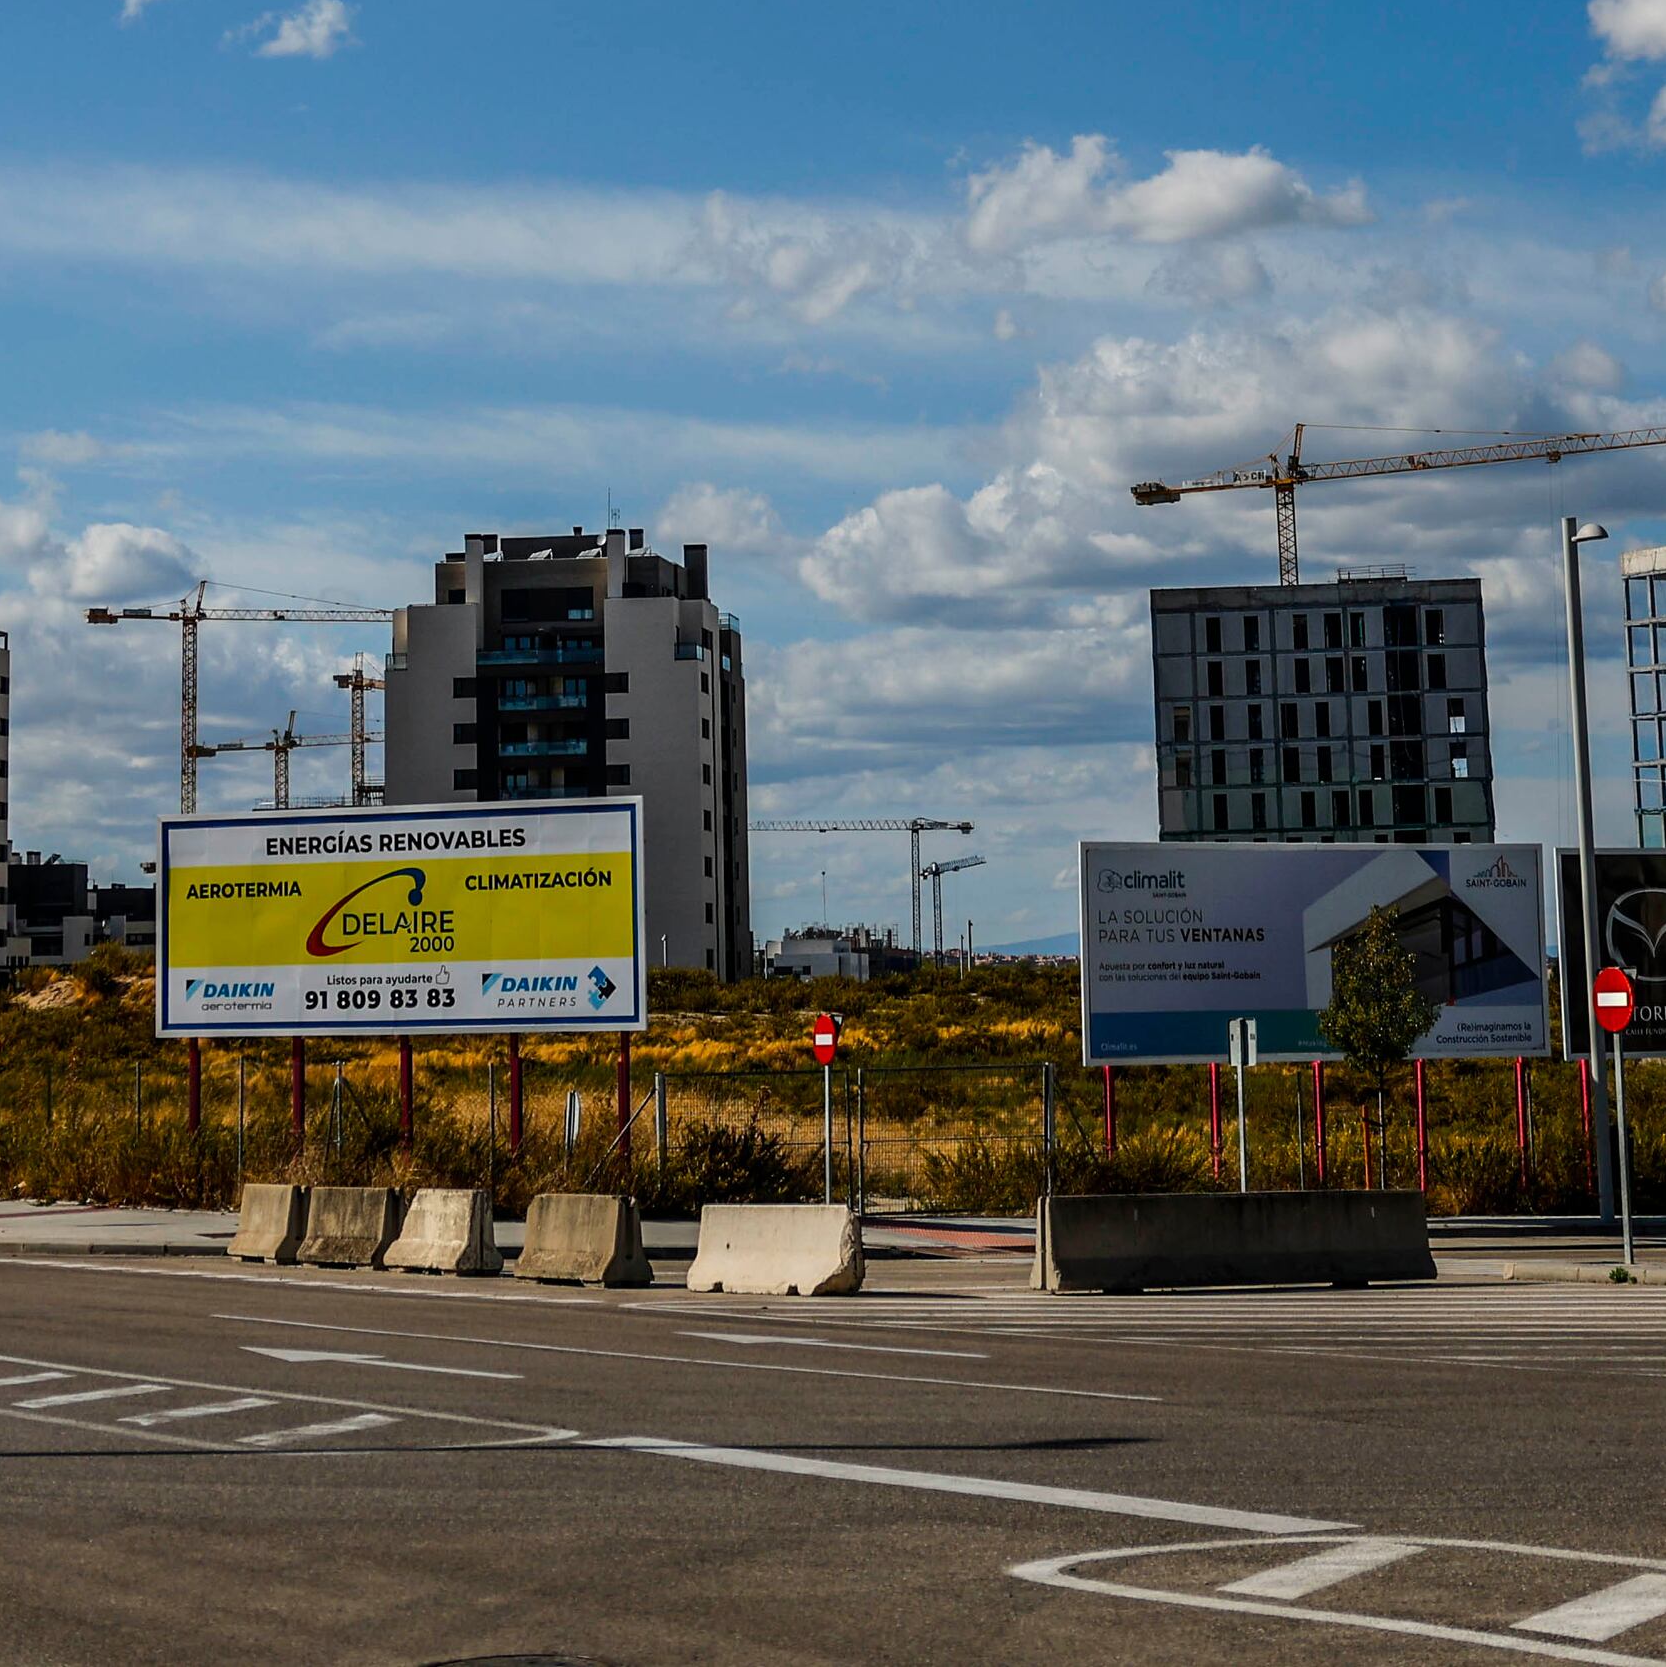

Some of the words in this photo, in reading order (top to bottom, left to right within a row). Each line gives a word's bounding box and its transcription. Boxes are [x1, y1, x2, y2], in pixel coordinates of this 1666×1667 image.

[266, 830, 373, 856] ENERGÍAS
[379, 828, 526, 852] RENOVABLES
[465, 867, 612, 891] CLIMATIZACIÓN
[1124, 870, 1185, 889] climalit
[1466, 879, 1527, 888] SAINT-GOBAIN
[186, 881, 302, 900] AEROTERMIA
[342, 910, 455, 936] DELAIRE
[1098, 910, 1118, 924] LA
[1124, 907, 1203, 923] SOLUCIÓN
[1099, 929, 1141, 943] PARA
[1146, 929, 1175, 942] TUS
[1180, 928, 1265, 942] VENTANAS
[410, 936, 455, 953] 2000
[1099, 962, 1131, 971] Apuesta
[1132, 963, 1145, 972] por
[1147, 962, 1176, 970] confort
[1198, 961, 1225, 969] natural
[326, 974, 357, 985] Listos
[359, 974, 383, 986] para
[385, 972, 433, 986] ayudarte
[501, 975, 579, 992] DAIKIN
[1099, 974, 1113, 982] con
[1183, 973, 1210, 982] equipo
[1211, 971, 1261, 980] Saint-Gobain
[203, 982, 275, 998] DAIKIN
[201, 1001, 273, 1011] aerotermia
[305, 992, 329, 1010] 91
[336, 990, 382, 1009] 809
[389, 990, 418, 1009] 83
[426, 989, 456, 1008] 83
[498, 996, 577, 1008] PARTNERS
[1457, 1022, 1522, 1032] (Re)imaginamos
[1524, 1022, 1531, 1030] la
[1436, 1034, 1489, 1045] Construcción
[1490, 1032, 1532, 1043] Sostenible
